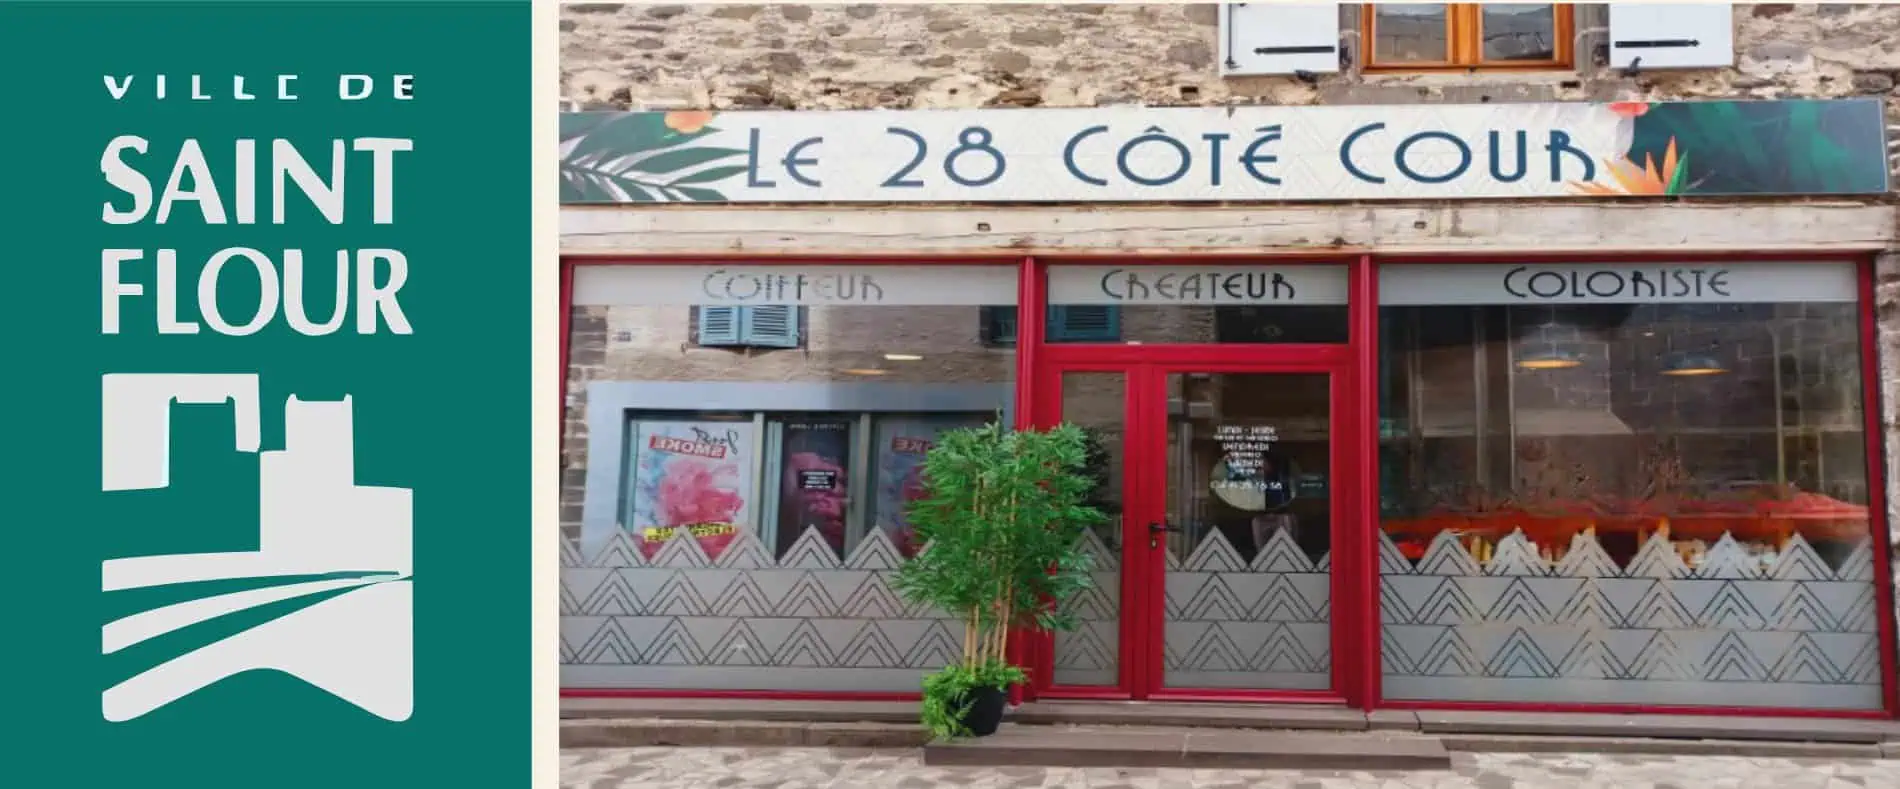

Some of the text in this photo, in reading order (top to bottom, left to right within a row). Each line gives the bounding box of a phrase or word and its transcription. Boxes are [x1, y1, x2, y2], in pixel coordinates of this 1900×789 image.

[880, 127, 1005, 187] 28
[1064, 122, 1281, 187] CÔTÉ
[1340, 121, 1595, 183] COUR
[702, 267, 885, 302] COIFFEUR
[1101, 268, 1296, 301] CREATEUR
[1503, 265, 1731, 299] COLORISTE
